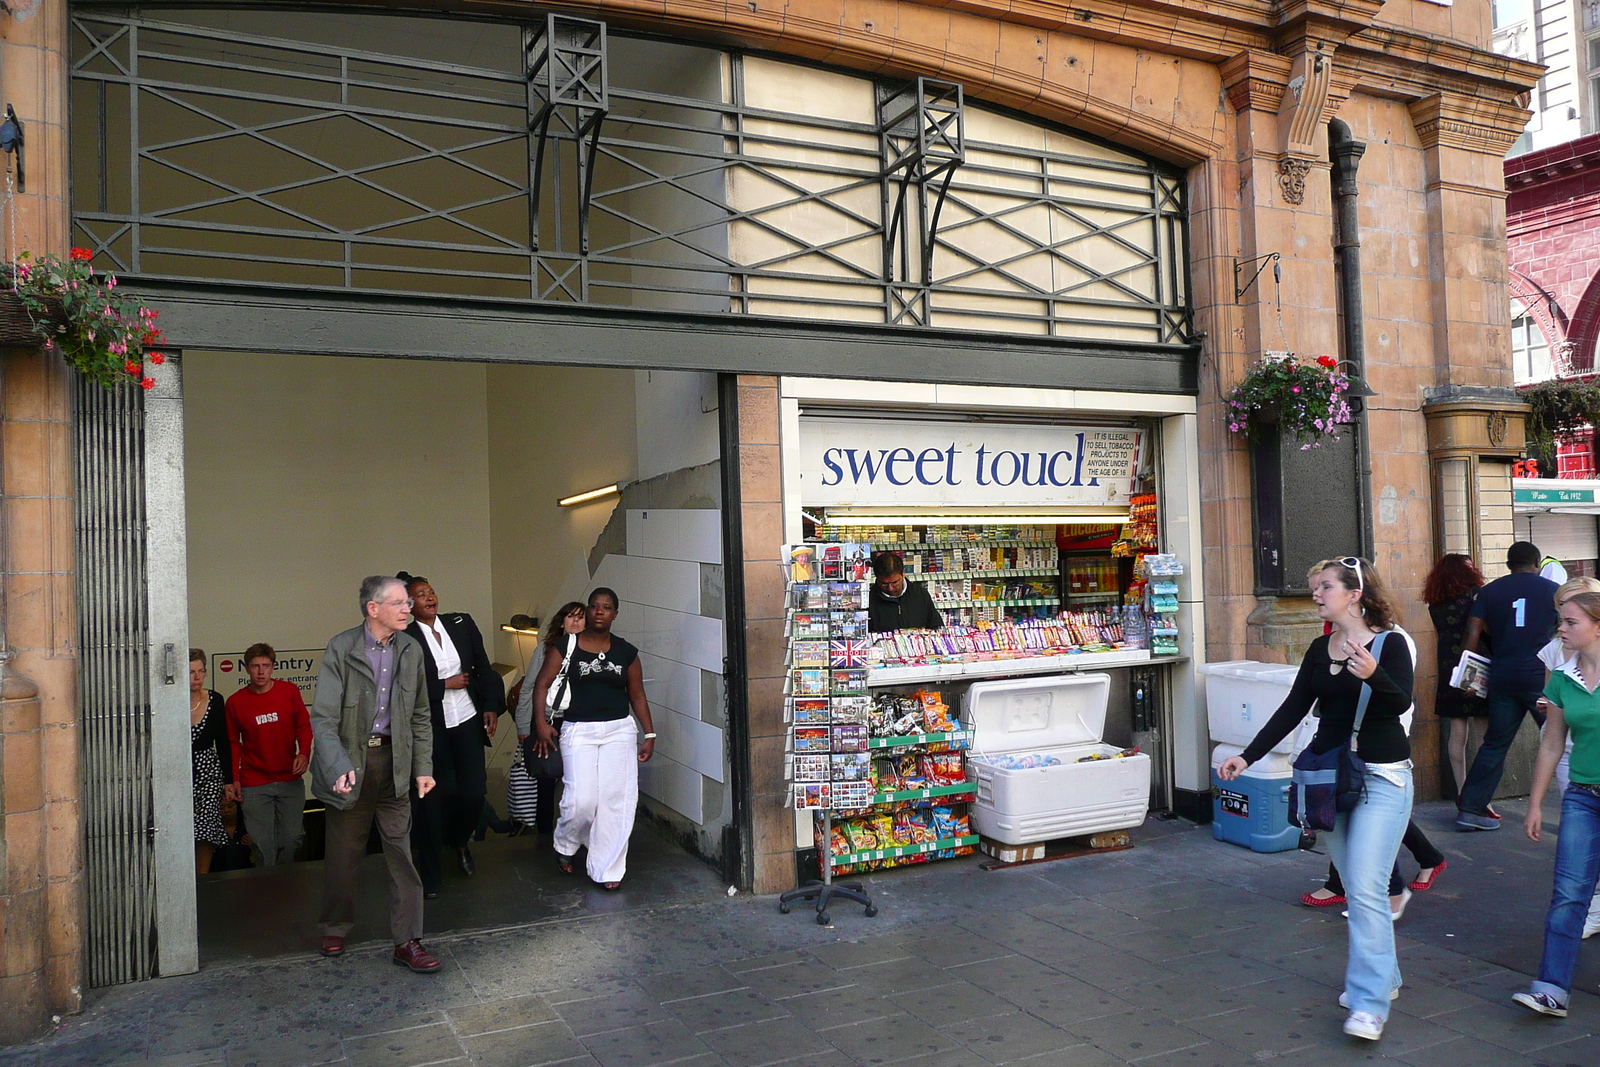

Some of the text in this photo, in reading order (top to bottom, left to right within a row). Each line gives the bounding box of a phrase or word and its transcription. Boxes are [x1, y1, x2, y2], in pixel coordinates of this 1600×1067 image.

[1108, 442, 1134, 450] TOBACCO
[1120, 451, 1127, 459] TO
[821, 442, 963, 486] sweet
[1512, 598, 1526, 627] 1
[273, 657, 314, 672] entry
[287, 675, 319, 683] entranc
